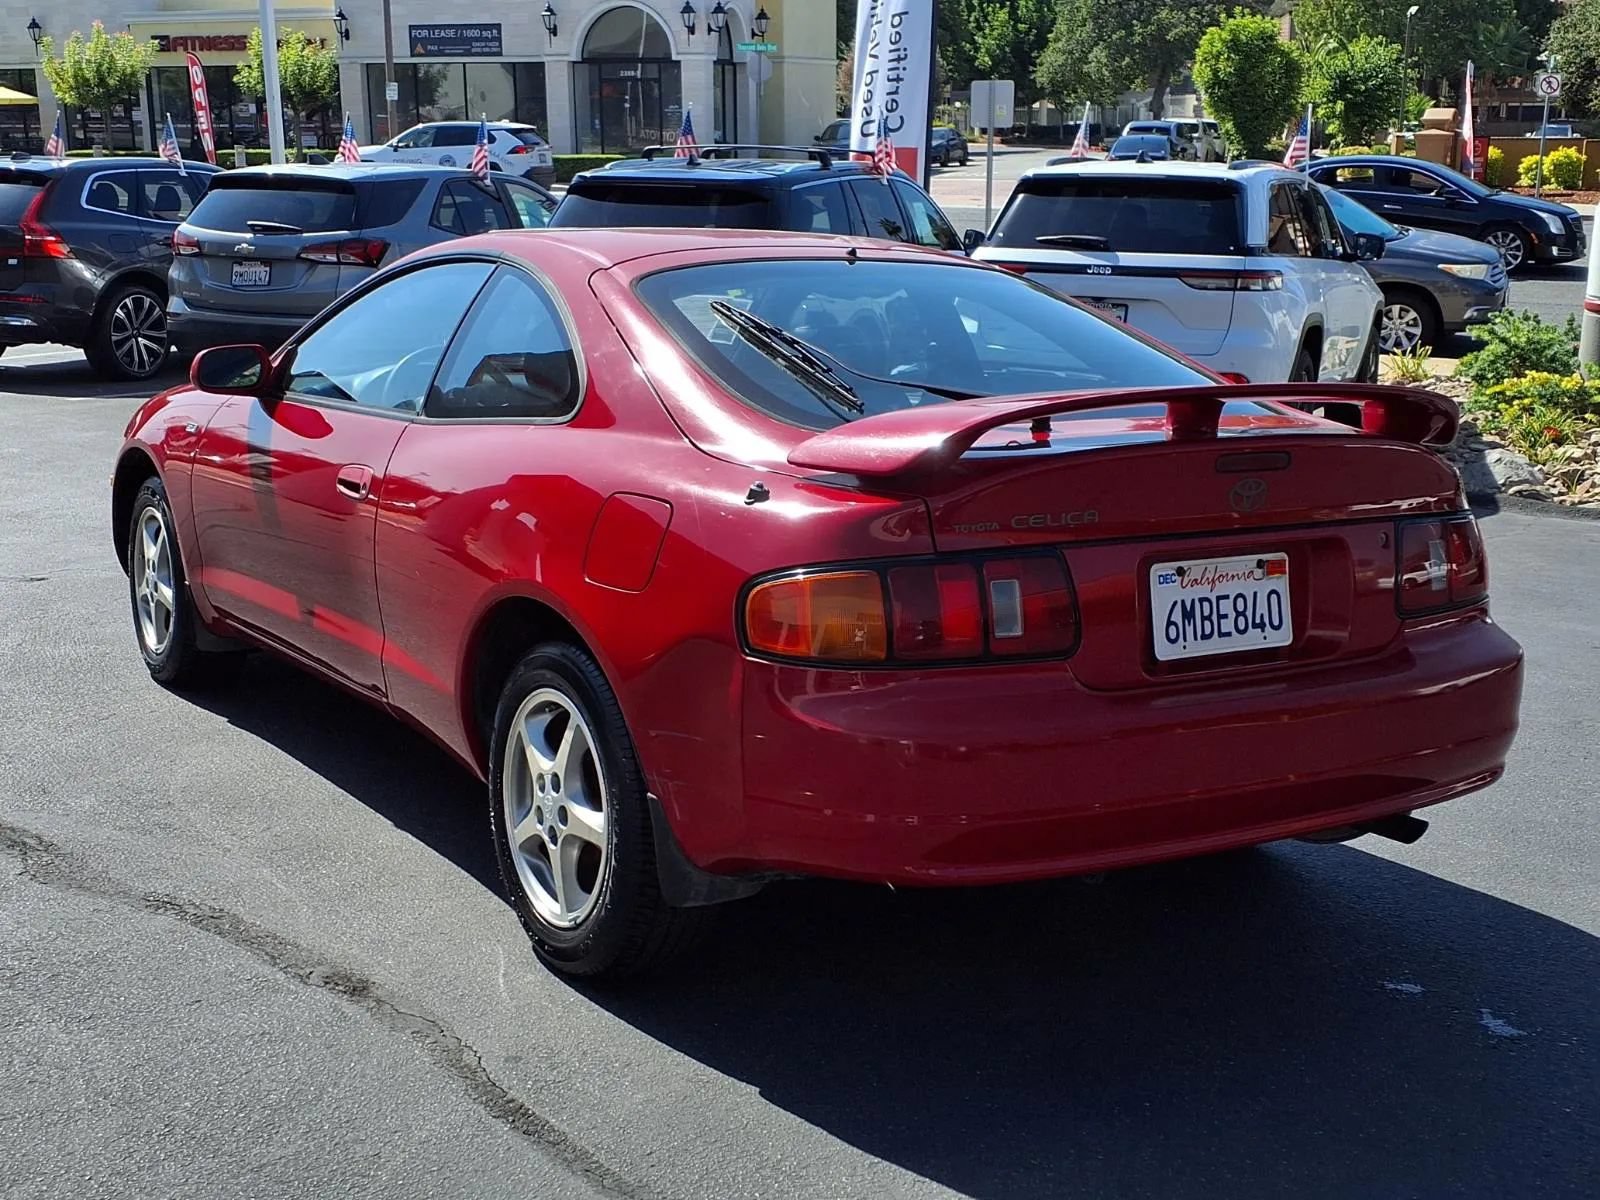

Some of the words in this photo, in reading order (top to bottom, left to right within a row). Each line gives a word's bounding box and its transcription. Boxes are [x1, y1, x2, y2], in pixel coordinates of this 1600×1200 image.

[411, 29, 429, 38] FOR
[430, 29, 456, 38] LEASE
[463, 28, 480, 37] 1600
[171, 35, 248, 51] FITNESS
[1087, 265, 1112, 275] Jeep
[952, 522, 999, 533] TOYOTA
[1011, 510, 1099, 529] CELICA
[1158, 572, 1177, 585] DEC
[1180, 565, 1264, 593] California
[1165, 589, 1283, 645] 6MBE840
